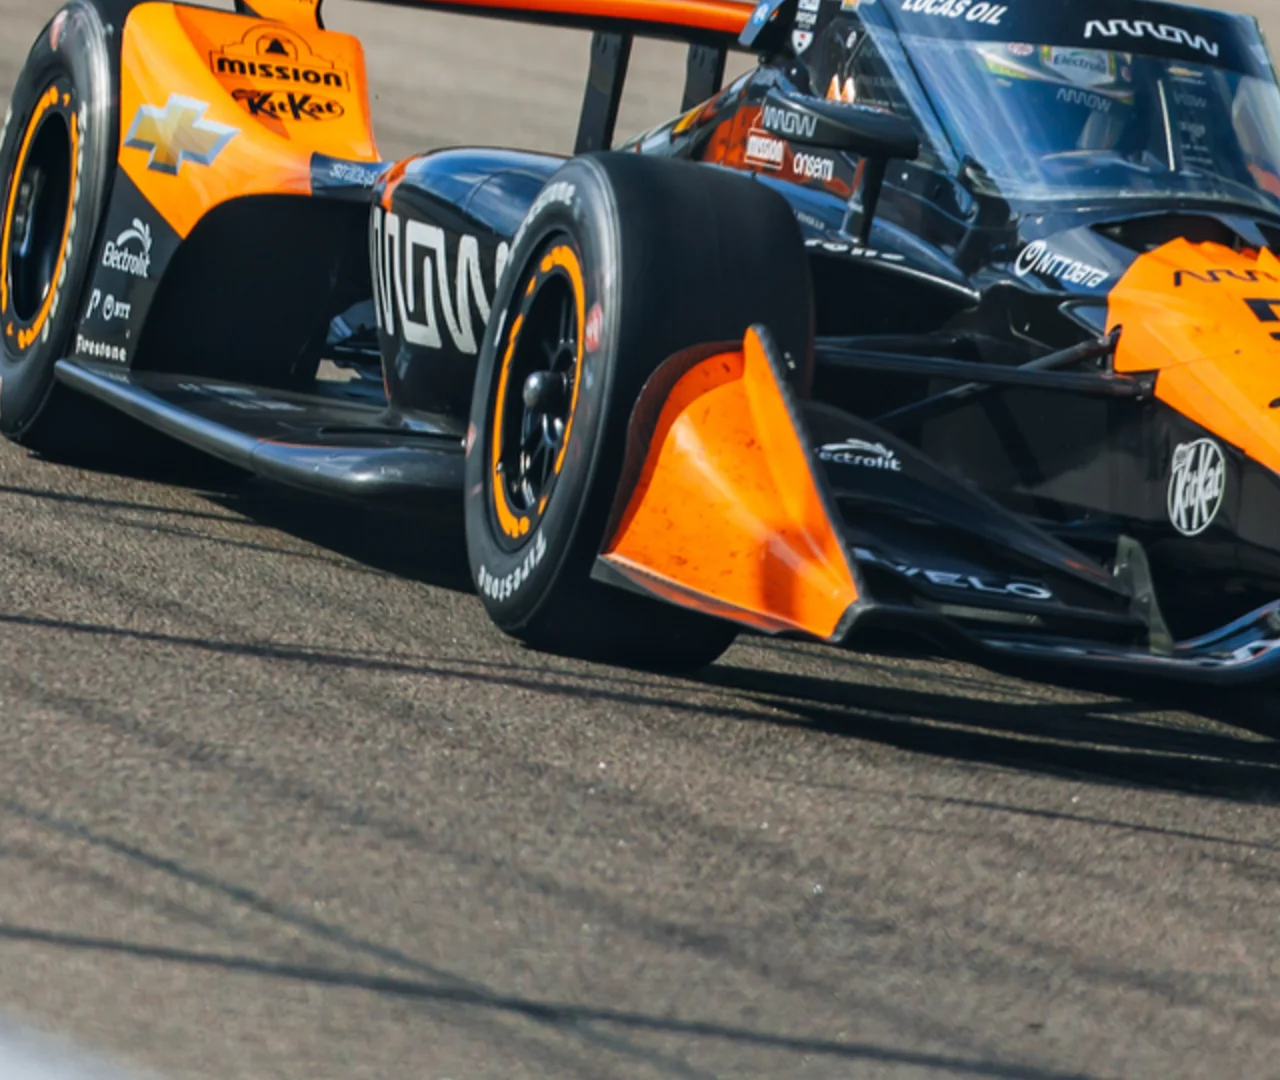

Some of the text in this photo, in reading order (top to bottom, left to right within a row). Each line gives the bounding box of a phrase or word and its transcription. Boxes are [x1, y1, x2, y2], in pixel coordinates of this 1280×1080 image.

[969, 0, 1009, 26] OIL
[1083, 18, 1219, 58] ARROW
[216, 56, 343, 88] mission
[792, 150, 835, 183] onsemi
[818, 449, 903, 472] ectrolit
